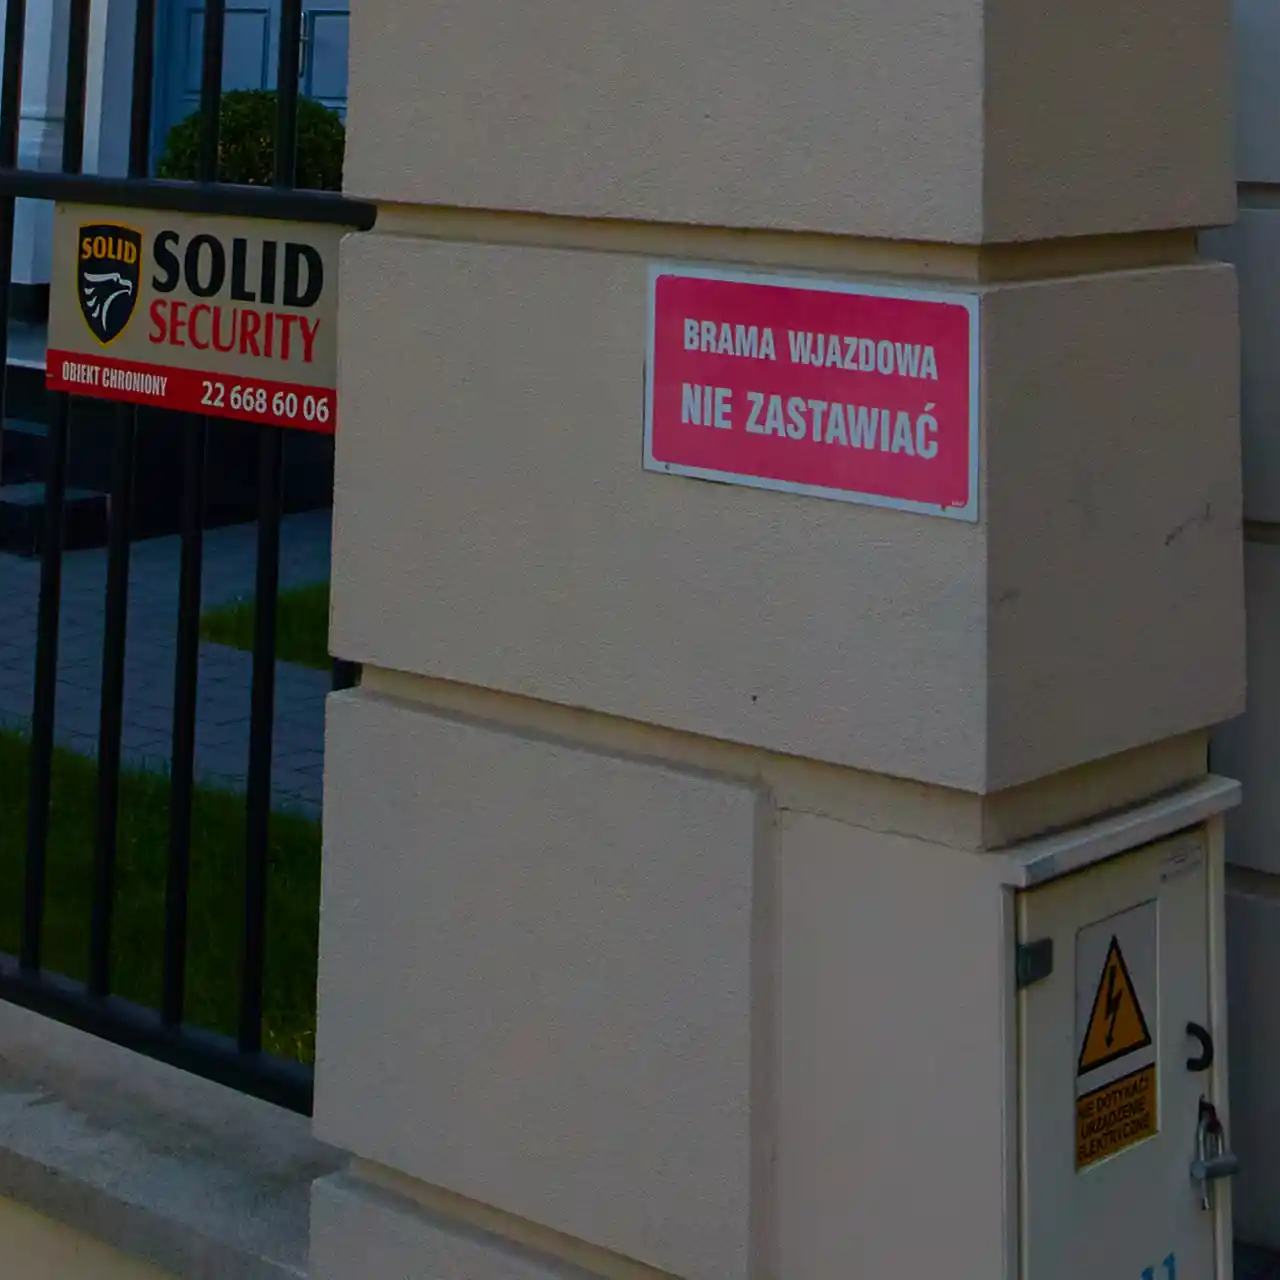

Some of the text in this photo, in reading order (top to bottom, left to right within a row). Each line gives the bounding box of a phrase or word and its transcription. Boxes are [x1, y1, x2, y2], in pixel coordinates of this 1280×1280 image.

[81, 236, 137, 264] SOLID
[151, 230, 324, 308] SOLID
[148, 298, 320, 364] SECURITY
[683, 318, 938, 380] BRAMA WJAZDOWA
[62, 360, 168, 397] OBIEKT CHRONIONY
[201, 381, 329, 423] 22 668 60 06
[681, 383, 939, 459] NIE ZASTAWIAĆ
